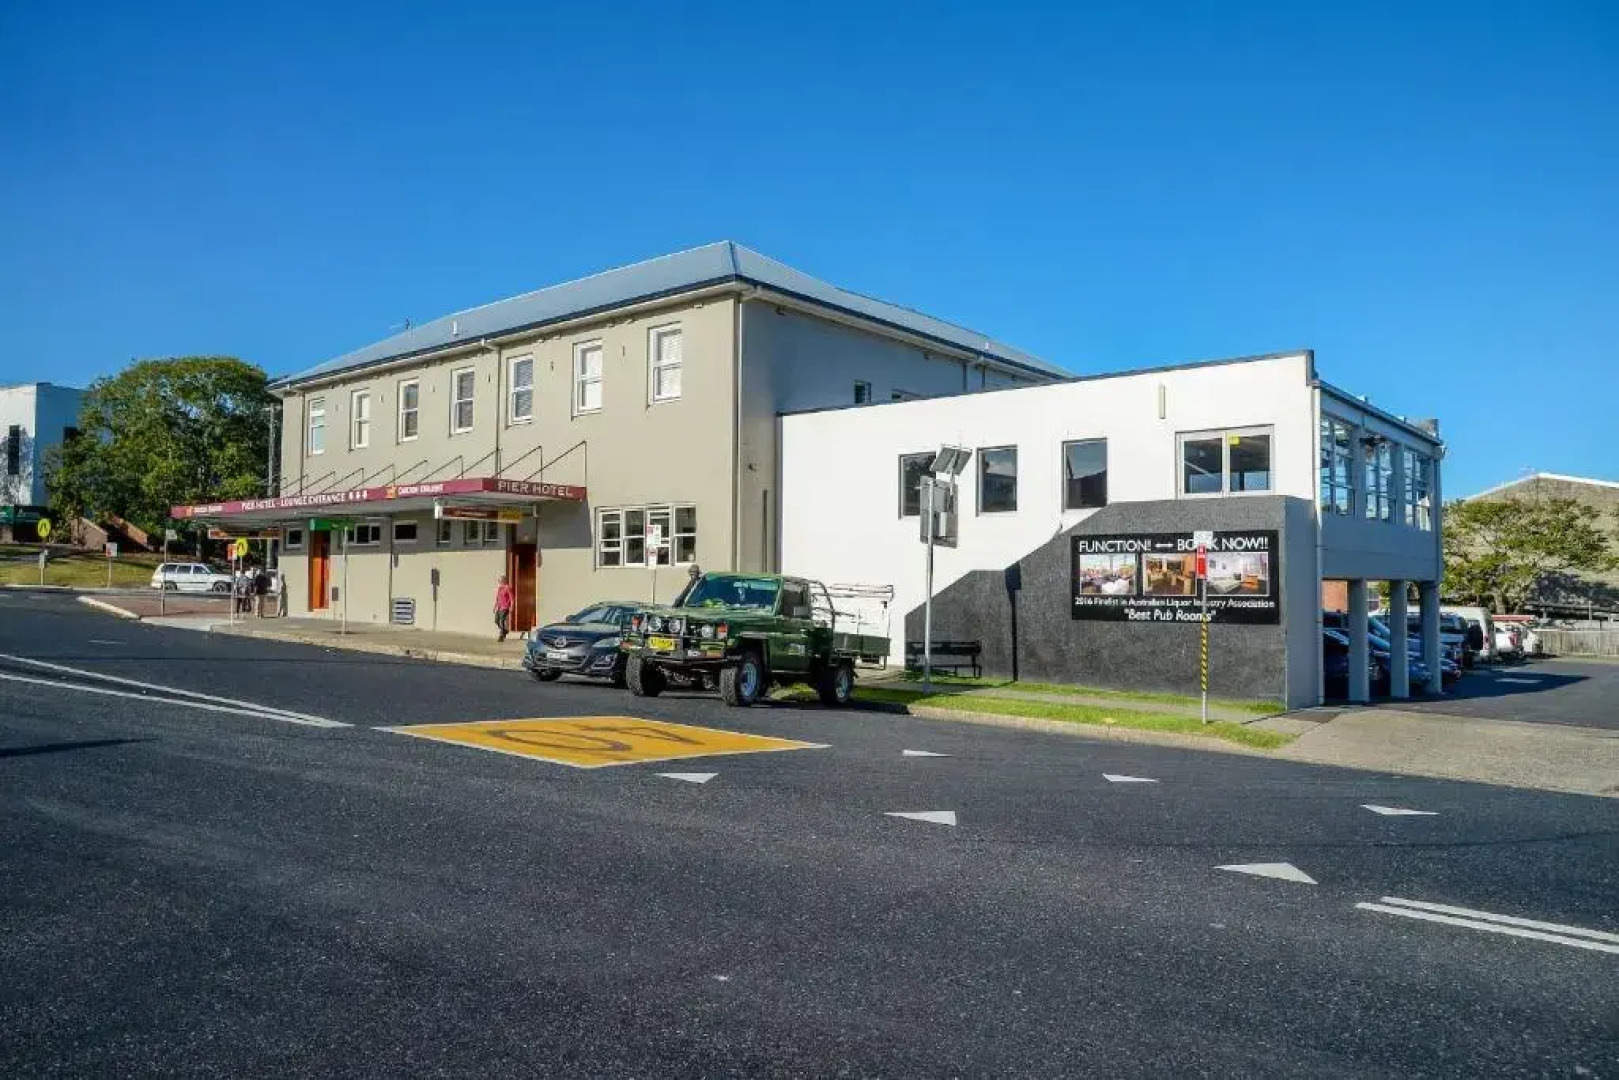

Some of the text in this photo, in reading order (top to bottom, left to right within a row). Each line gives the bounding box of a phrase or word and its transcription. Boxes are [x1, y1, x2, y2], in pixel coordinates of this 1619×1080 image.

[497, 480, 573, 498] PIER HOTEL
[308, 492, 346, 505] ENTRANCE
[1177, 537, 1219, 551] BOK
[1221, 536, 1268, 550] NOW!!
[1128, 597, 1165, 606] Australian
[1166, 598, 1192, 608] Liquor
[1227, 599, 1275, 608] Association
[1153, 609, 1173, 620] Pub
